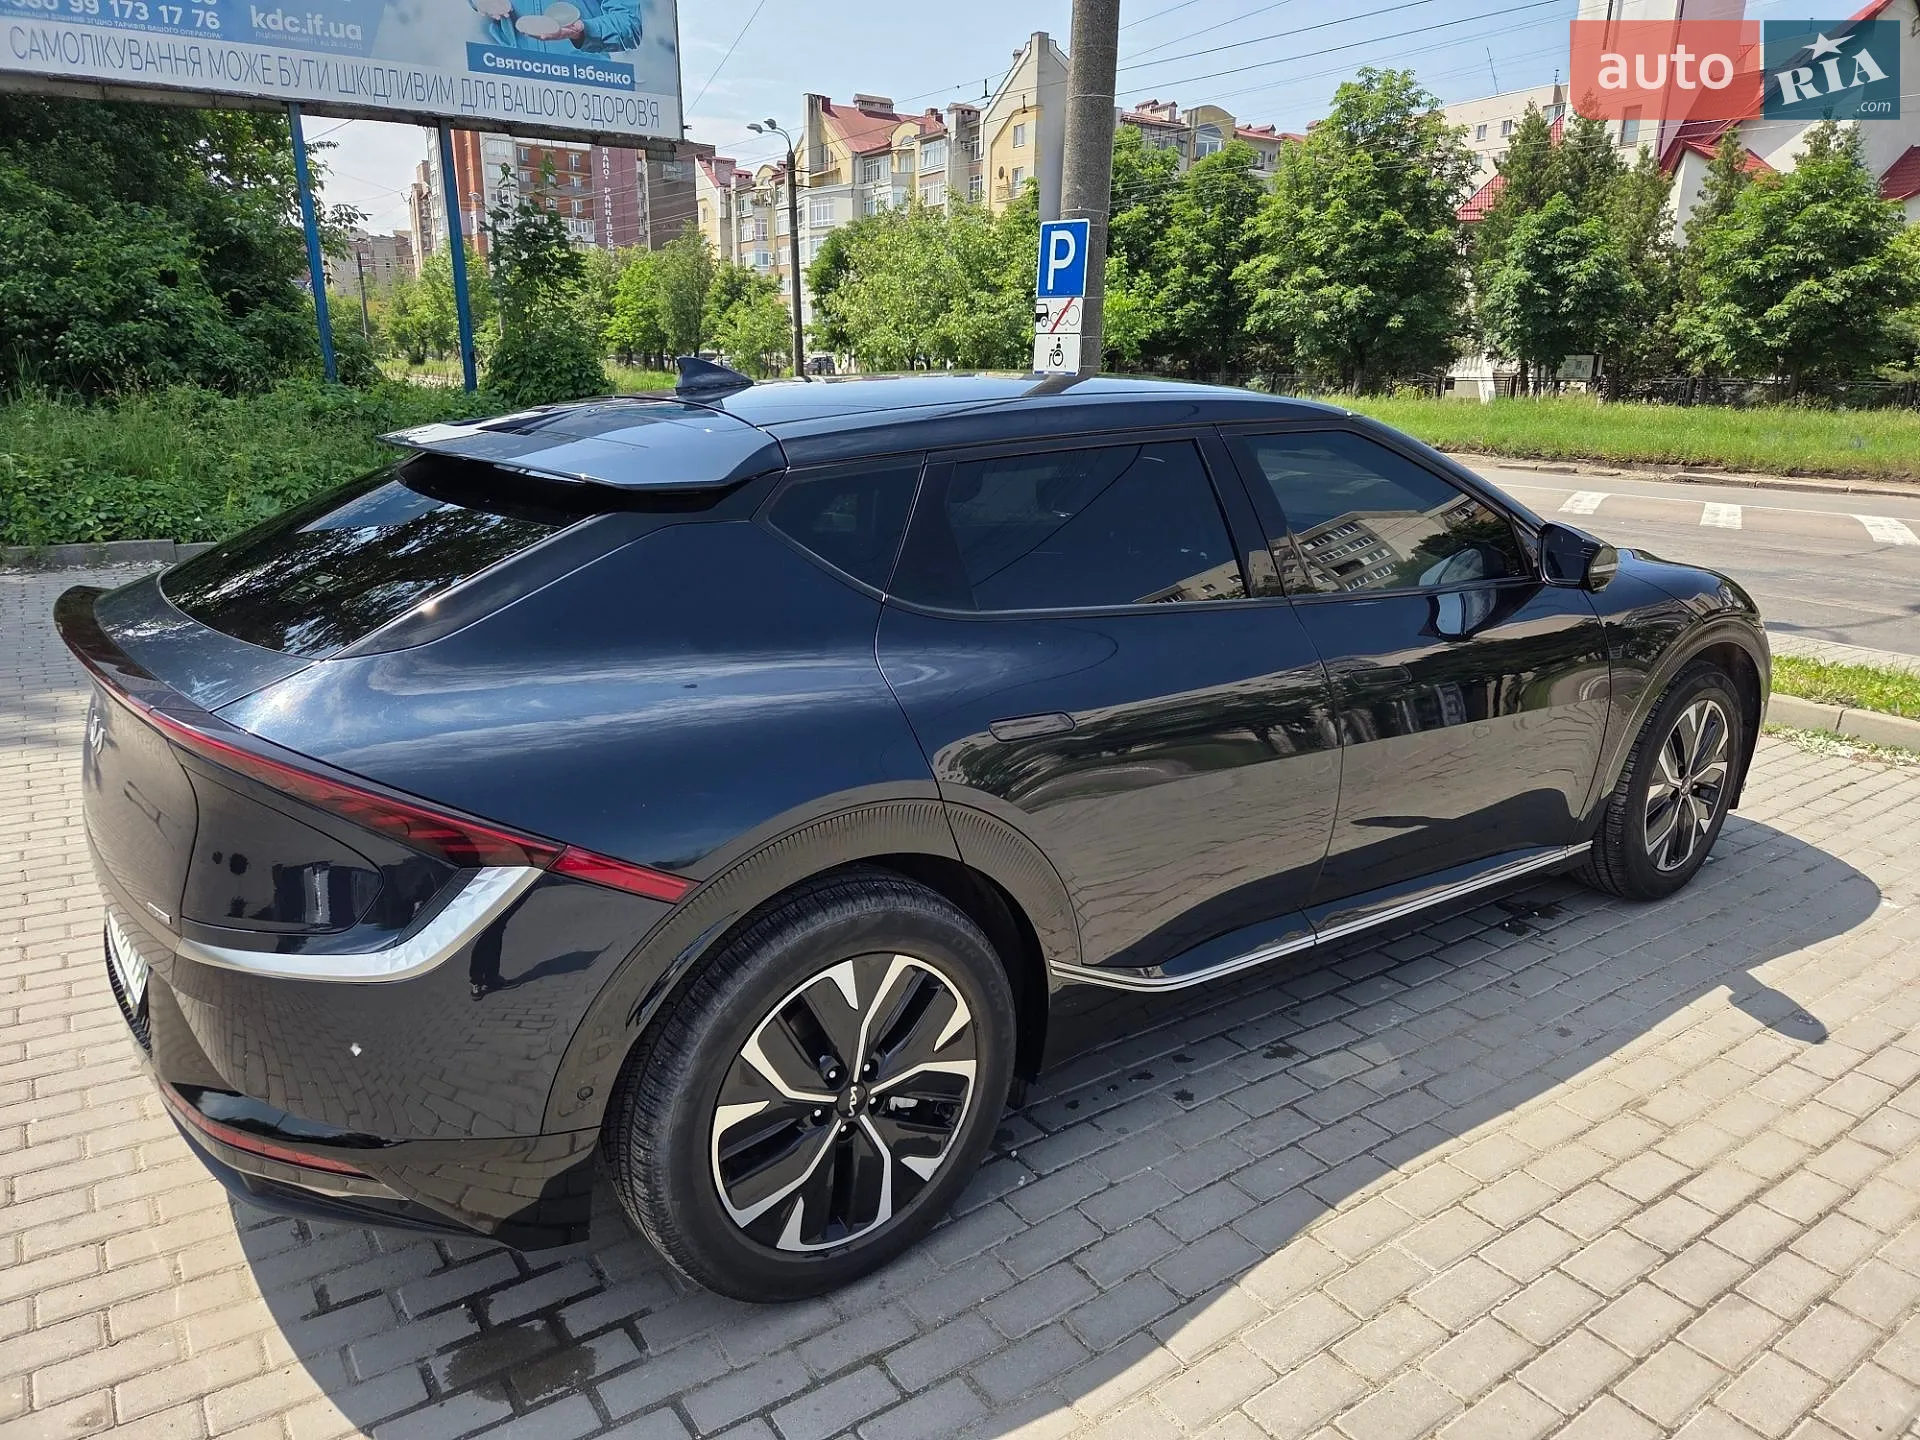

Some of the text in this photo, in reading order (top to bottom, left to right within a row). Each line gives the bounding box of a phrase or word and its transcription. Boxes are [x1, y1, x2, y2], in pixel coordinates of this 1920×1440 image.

[109, 0, 150, 21] 173
[158, 5, 183, 25] 17
[192, 8, 221, 30] 76
[249, 4, 362, 41] kdc.if.ua
[9, 26, 660, 130] САМОЛІКУВАННЯ МОЖЕ БУТИ ШКІДЛИВИМ ДЛЯ ВАШОГО ЗДОРОВ'Я
[482, 52, 632, 86] Святослав Ізбенко
[1046, 230, 1076, 290] P
